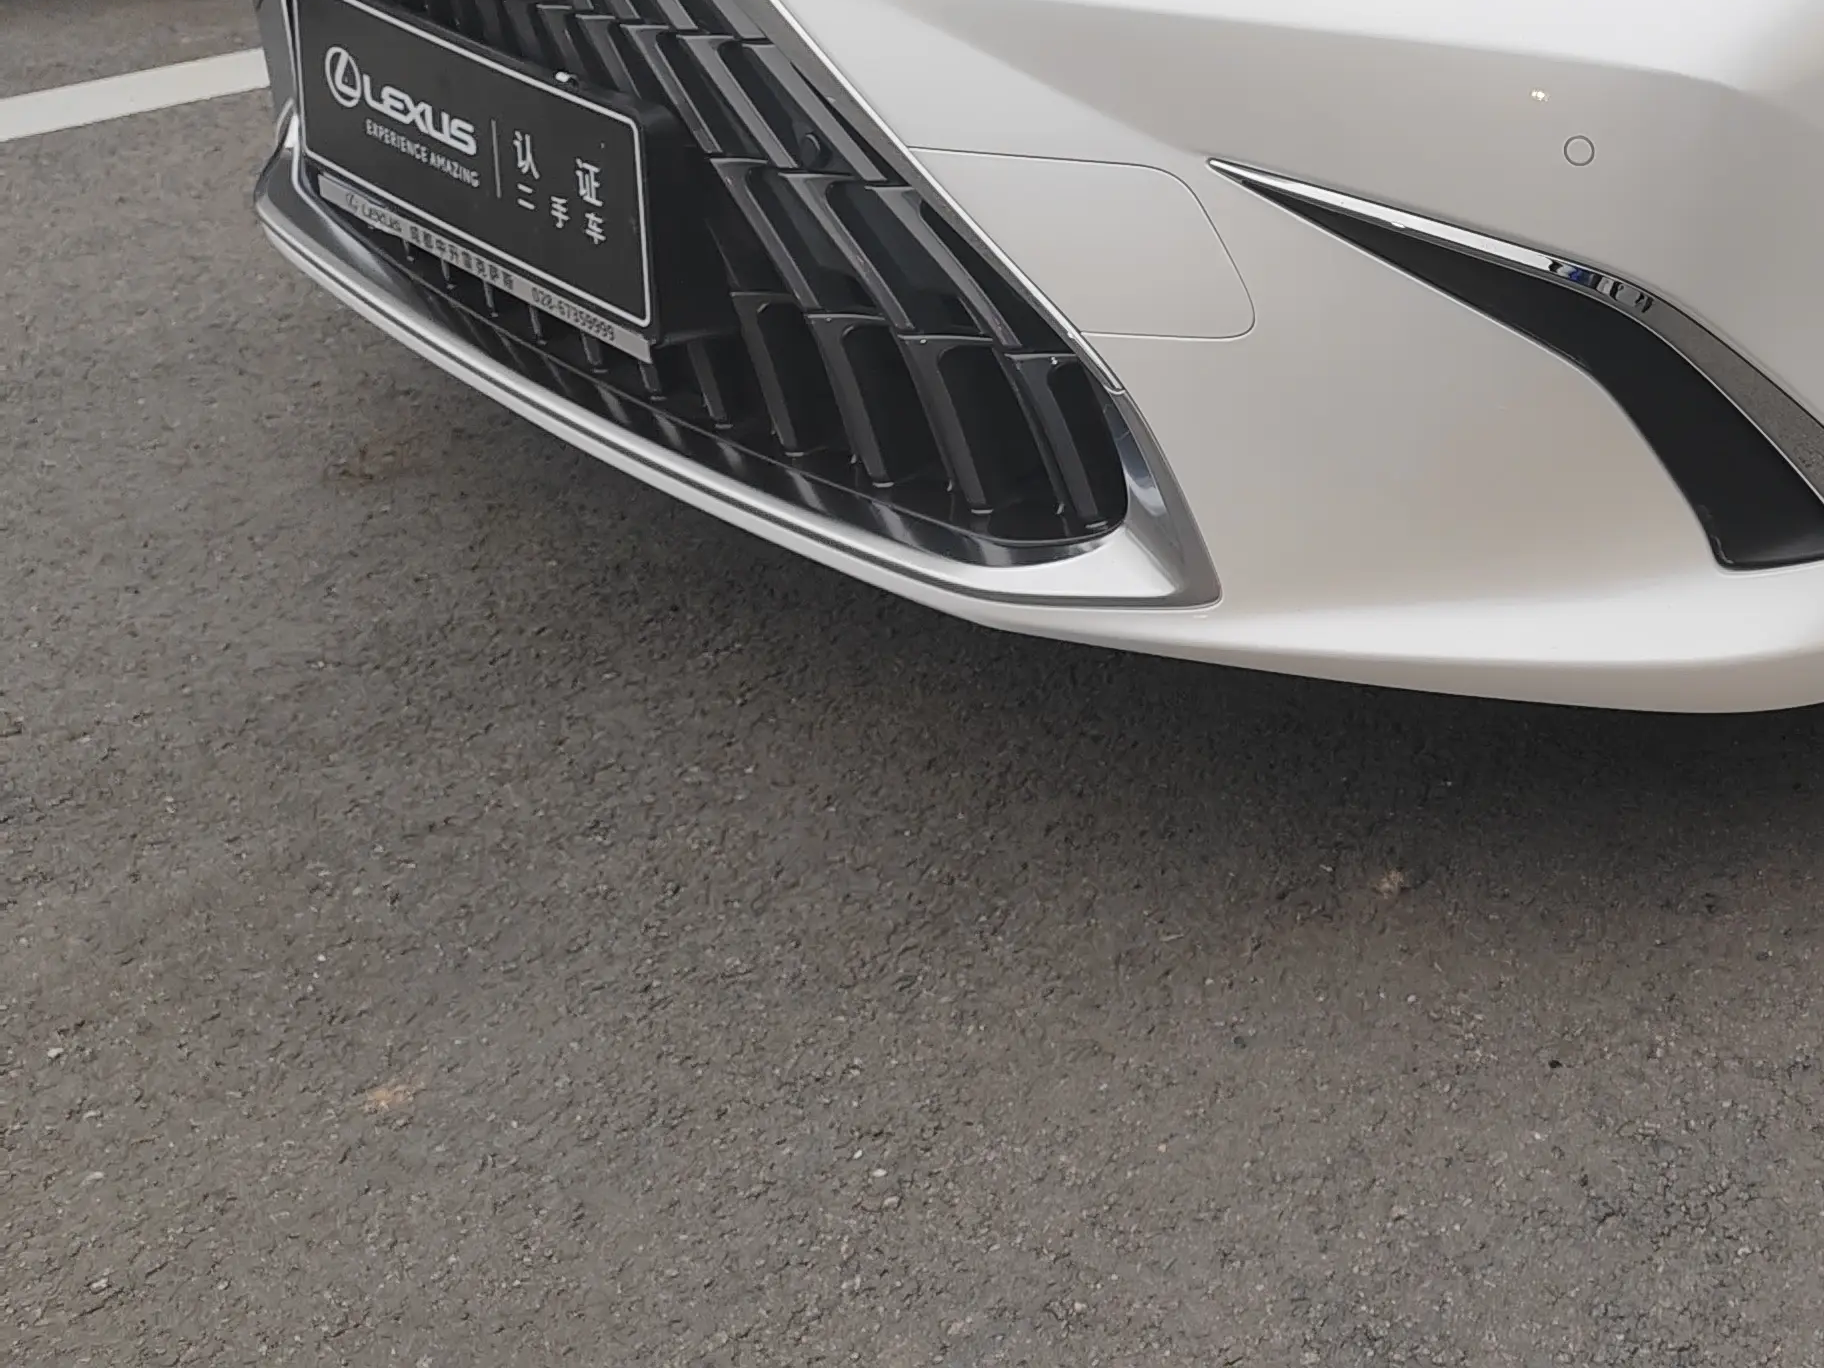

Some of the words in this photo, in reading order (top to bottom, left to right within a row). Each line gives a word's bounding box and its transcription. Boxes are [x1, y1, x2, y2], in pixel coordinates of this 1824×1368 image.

[362, 73, 477, 156] LEXUS
[365, 118, 428, 163] EXPERIENCE
[430, 150, 480, 188] AMAZING
